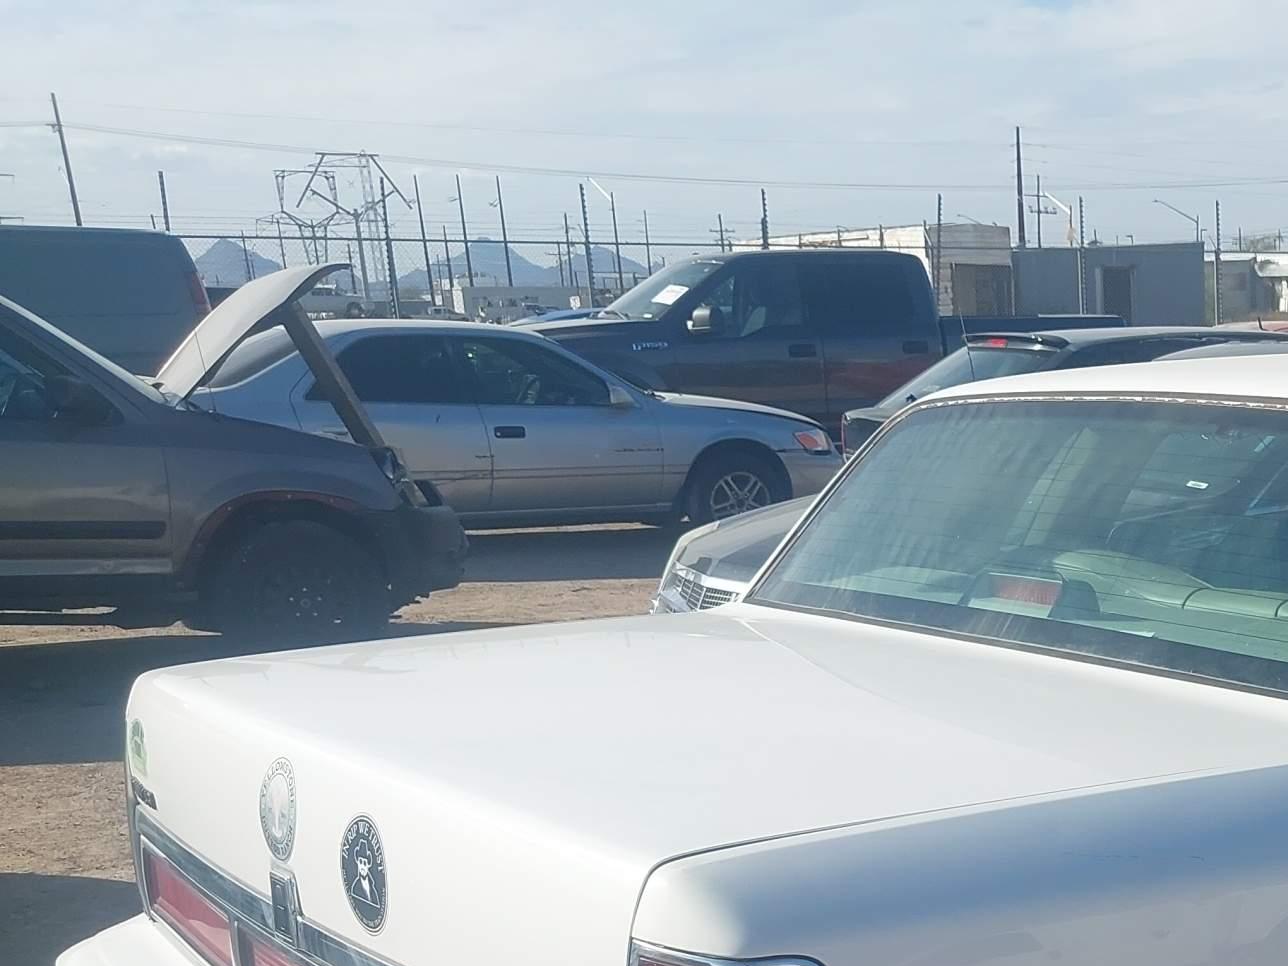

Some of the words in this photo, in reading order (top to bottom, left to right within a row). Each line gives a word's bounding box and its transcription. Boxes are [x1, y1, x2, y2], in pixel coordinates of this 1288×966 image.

[342, 840, 349, 858] IN
[347, 823, 358, 845] RIP
[358, 821, 369, 836] WE
[368, 826, 385, 873] TRUST
